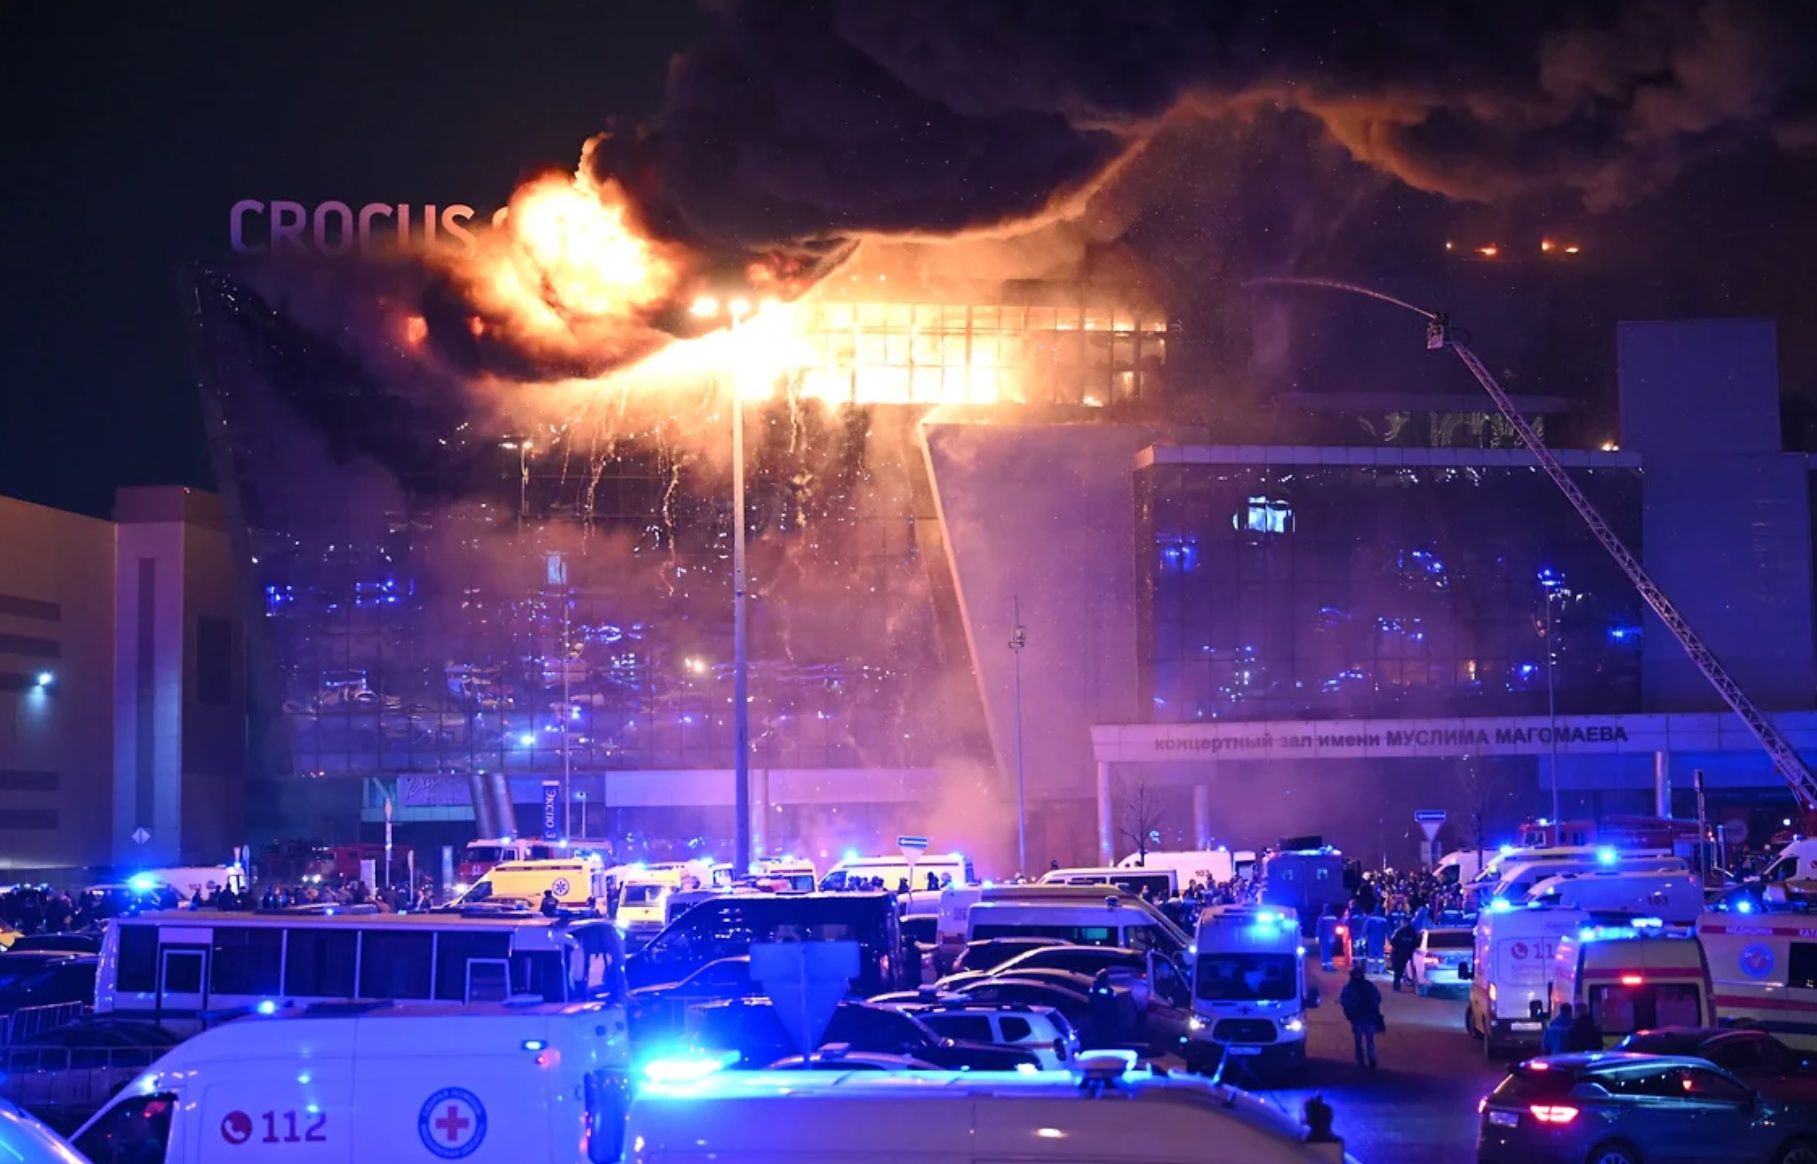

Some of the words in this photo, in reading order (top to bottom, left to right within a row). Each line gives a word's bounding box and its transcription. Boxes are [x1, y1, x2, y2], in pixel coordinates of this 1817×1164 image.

[230, 199, 478, 257] CROCUS
[1155, 733, 1273, 753] концертный
[1279, 735, 1313, 750] зал
[1318, 732, 1381, 748] имени
[1387, 729, 1490, 747] МУСЛИМА
[1496, 726, 1629, 745] МАГОМАЕВА
[544, 789, 556, 828] Экспо
[1533, 942, 1557, 960] 11
[261, 1109, 327, 1143] 112
